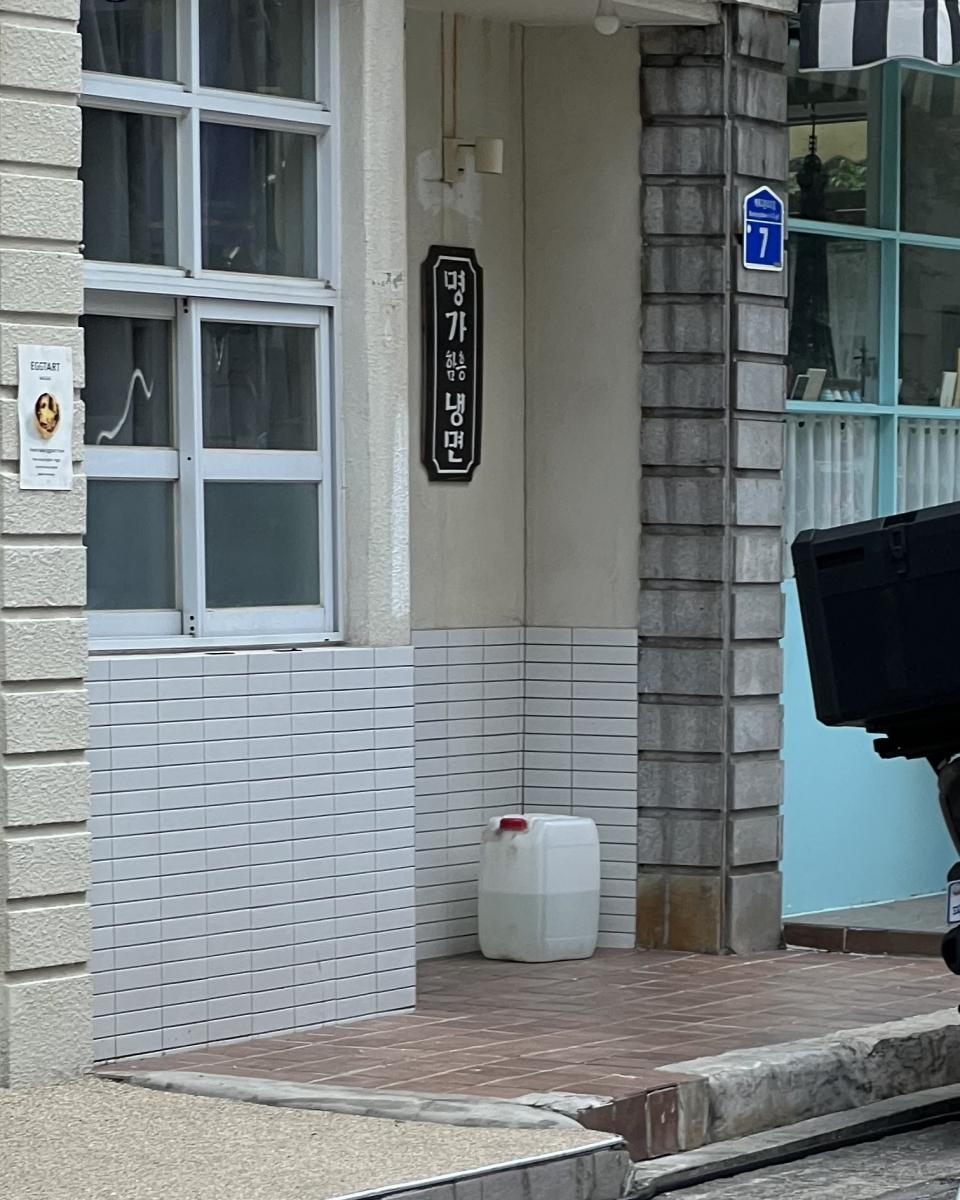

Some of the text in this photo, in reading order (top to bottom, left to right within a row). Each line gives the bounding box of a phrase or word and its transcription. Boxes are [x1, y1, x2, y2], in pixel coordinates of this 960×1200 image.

[758, 226, 769, 258] 7
[443, 269, 468, 463] 명가 함흥 냉면
